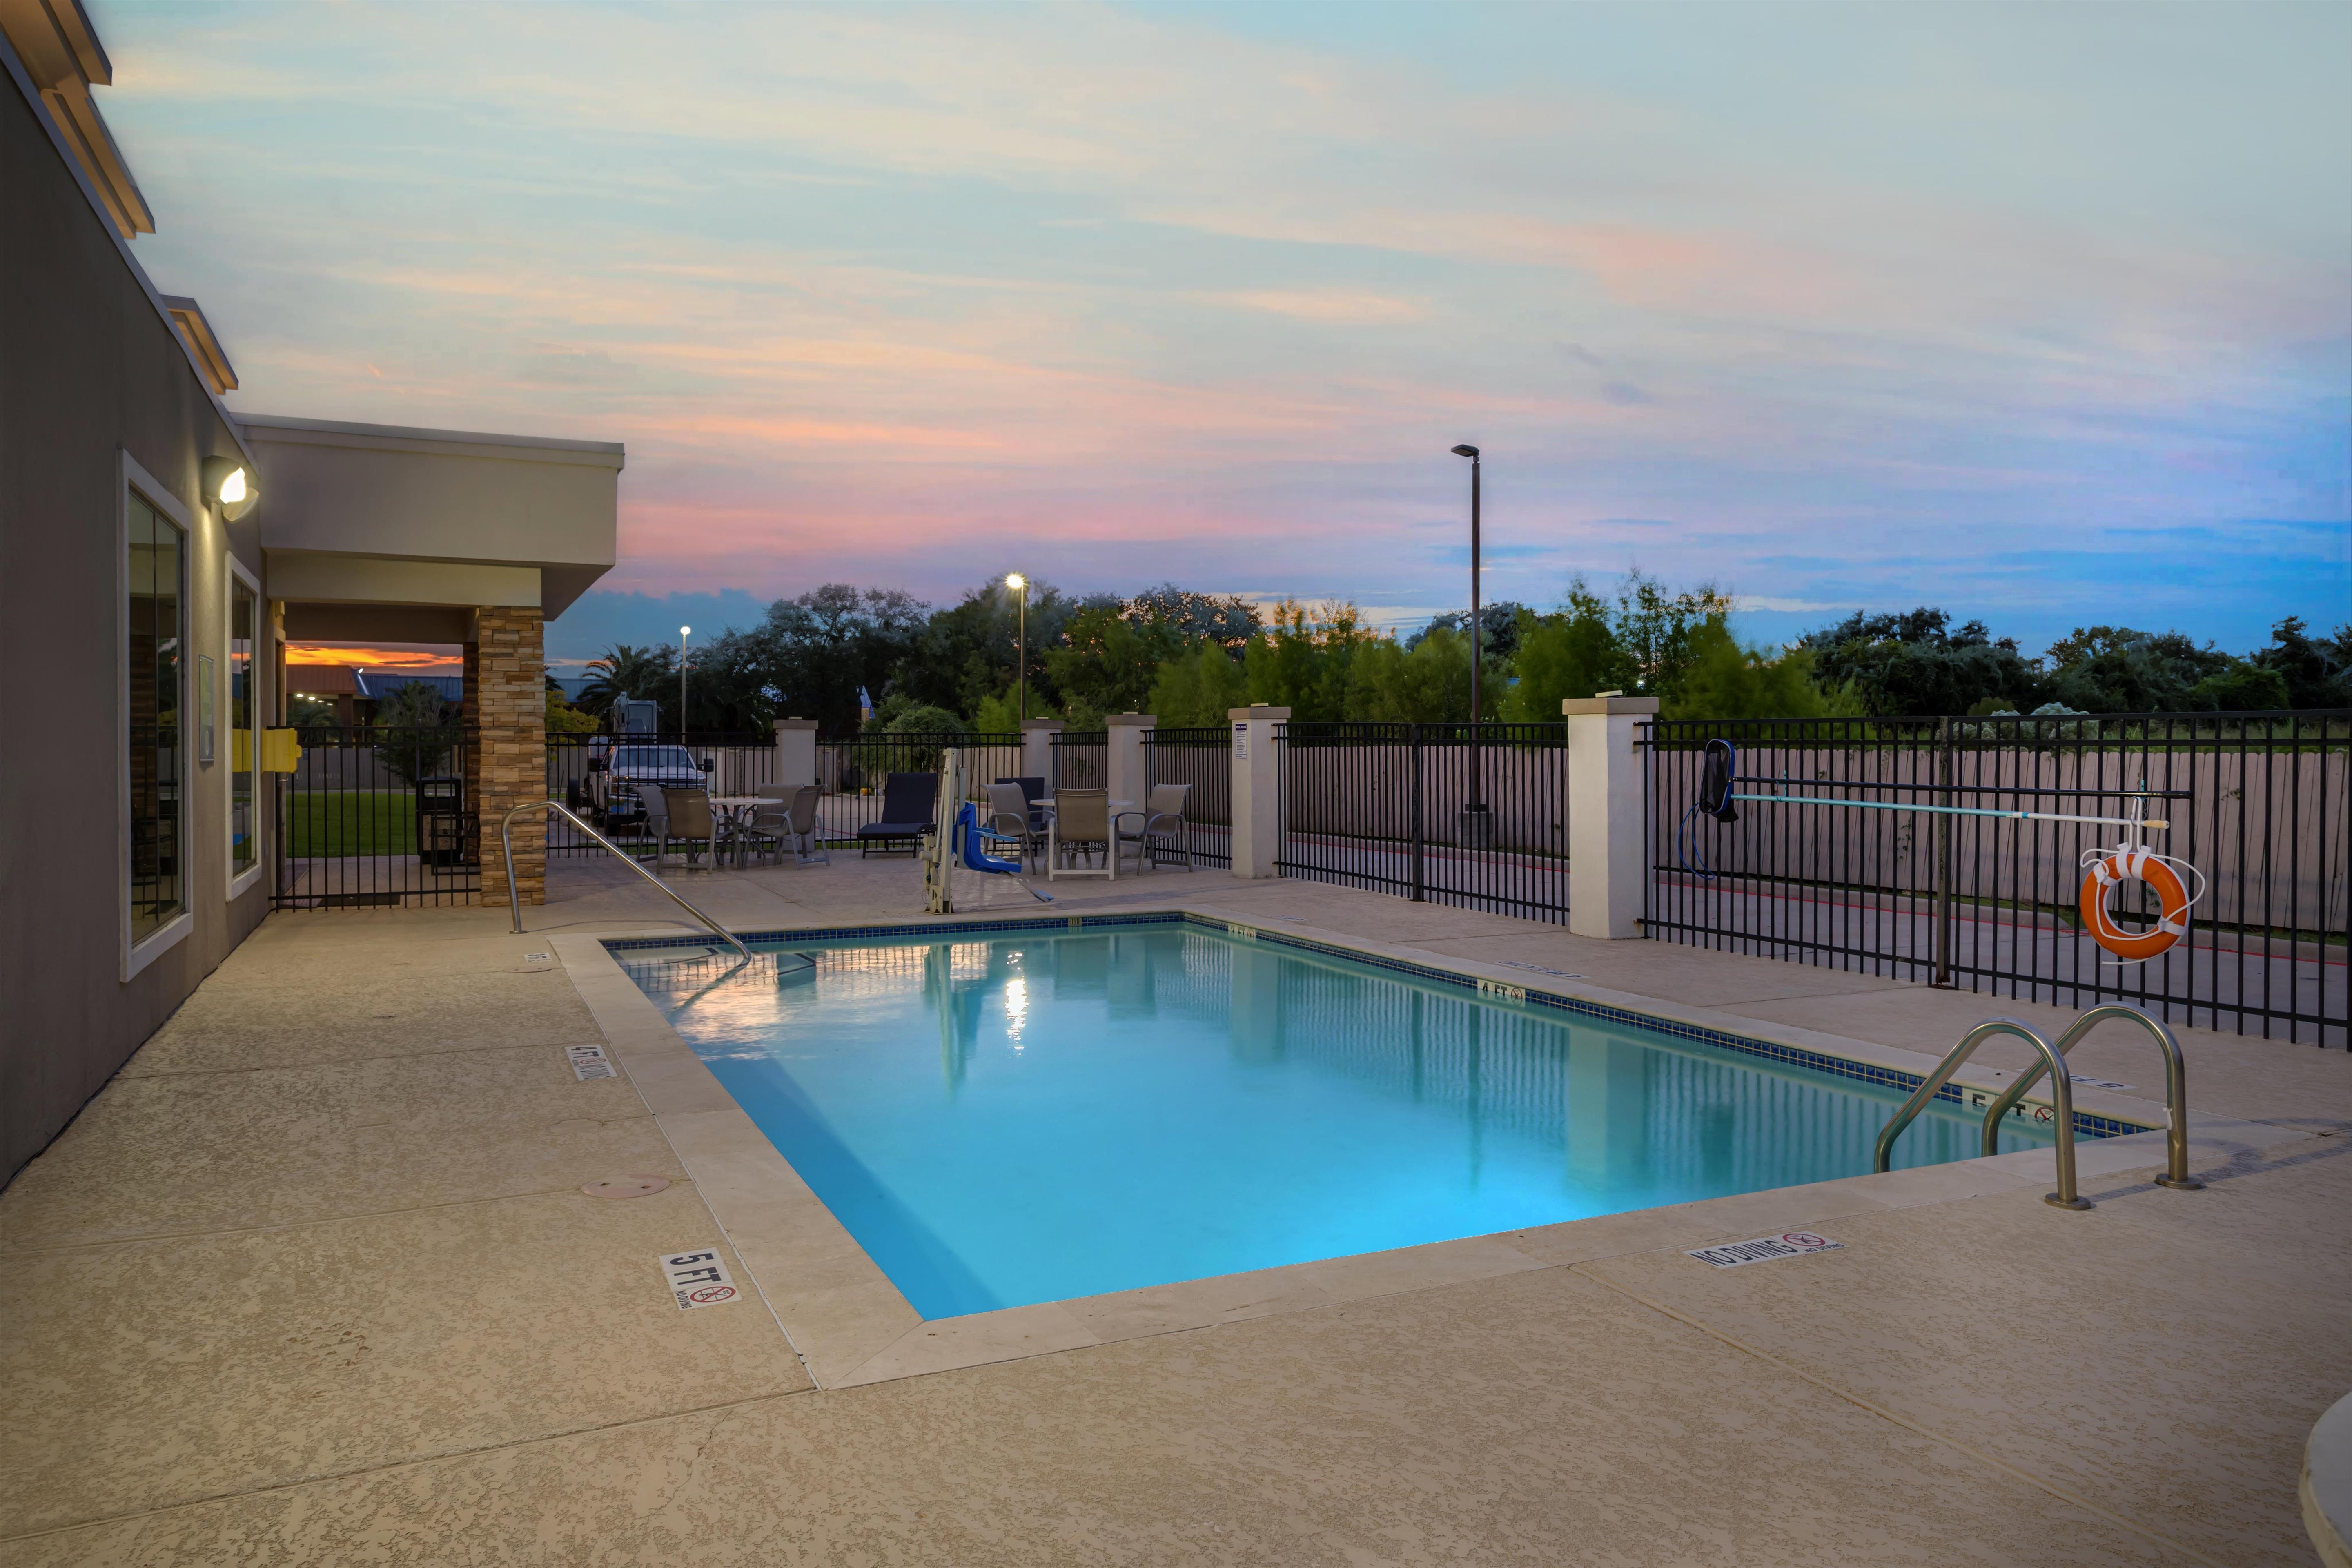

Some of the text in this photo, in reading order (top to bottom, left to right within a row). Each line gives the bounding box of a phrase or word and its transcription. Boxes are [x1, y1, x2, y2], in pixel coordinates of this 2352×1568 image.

[1689, 1240, 1798, 1266] NO DIVING
[670, 1253, 722, 1285] 5 FT
[678, 1296, 692, 1309] DIVING
